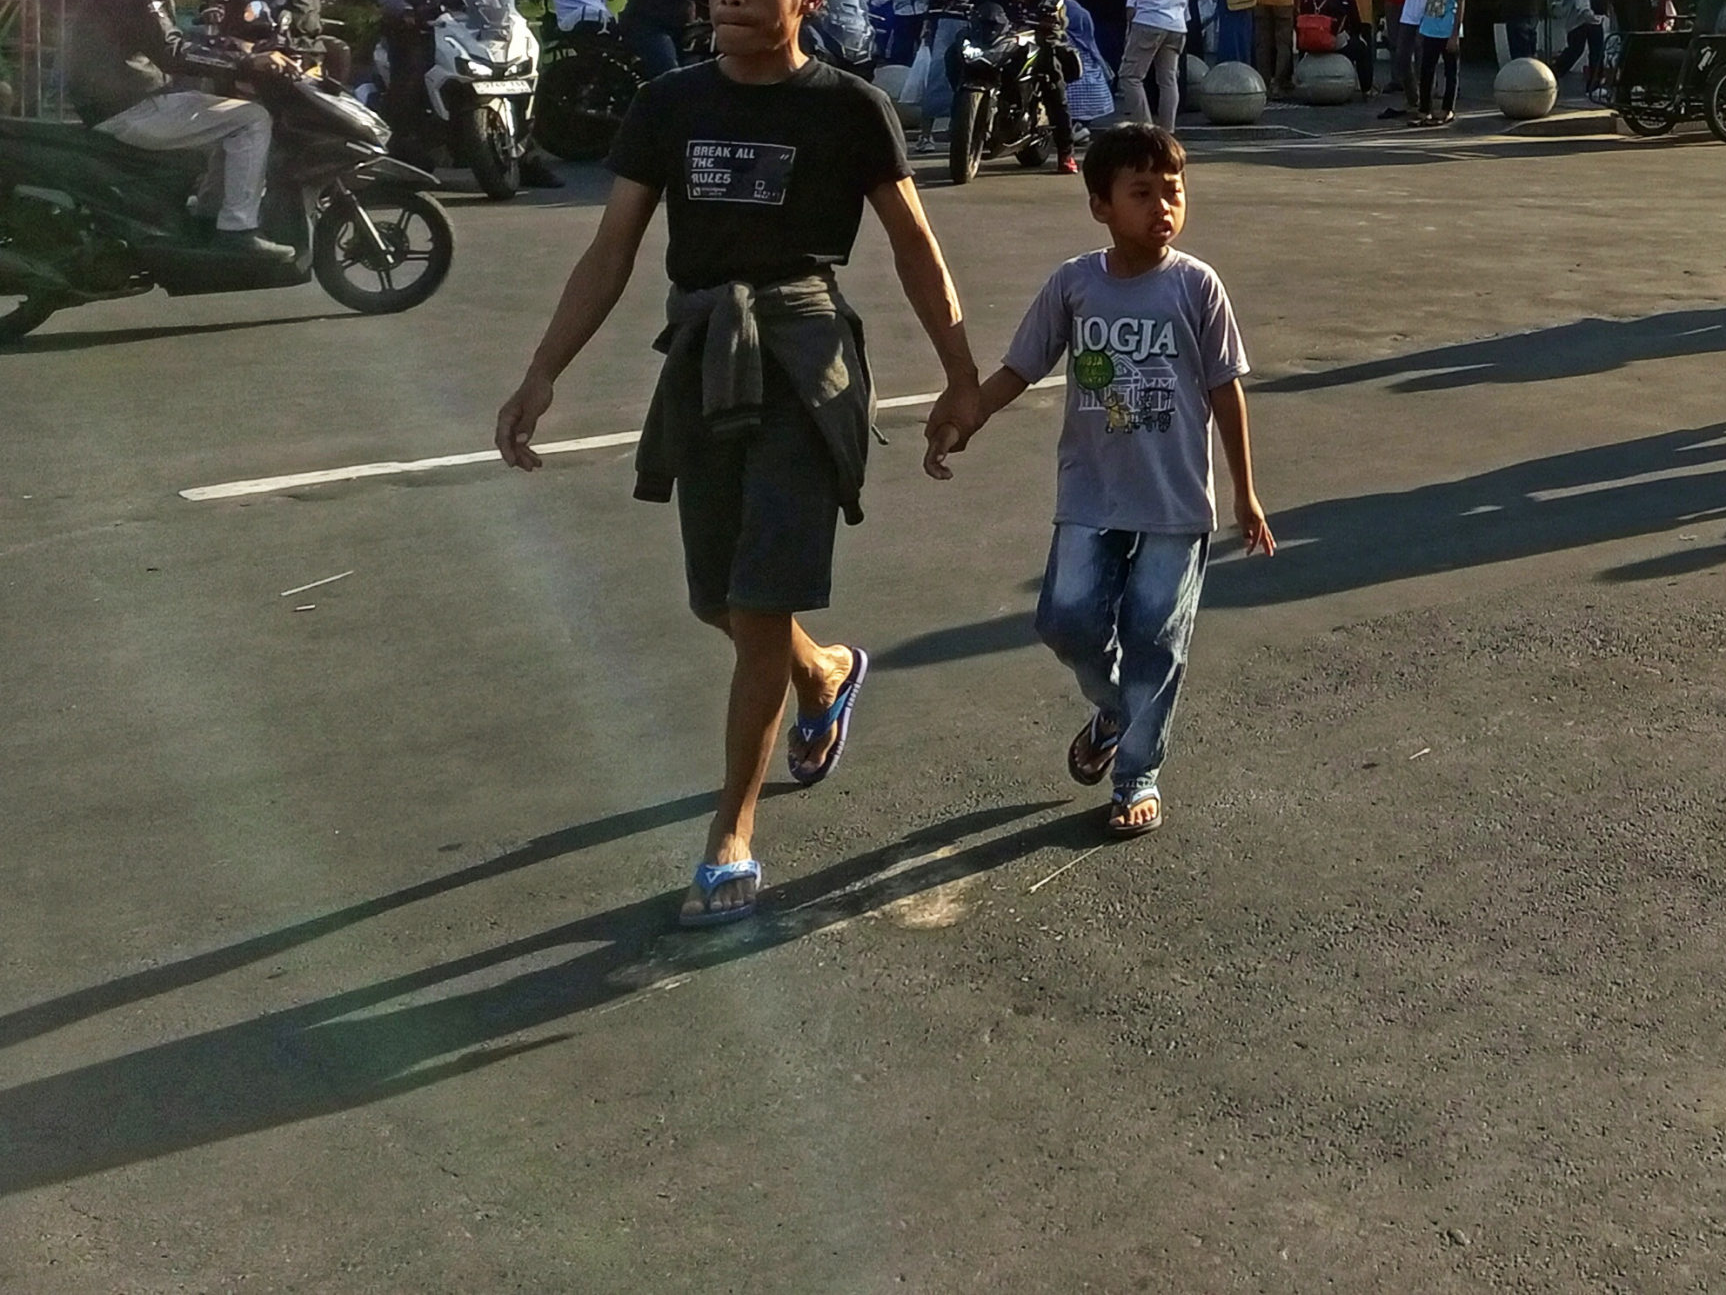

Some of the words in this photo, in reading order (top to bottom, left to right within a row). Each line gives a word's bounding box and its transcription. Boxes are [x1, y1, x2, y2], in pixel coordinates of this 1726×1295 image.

[693, 145, 732, 158] BREAK
[735, 147, 756, 159] ALL
[690, 172, 732, 184] RULES
[1072, 315, 1179, 362] JOGJA
